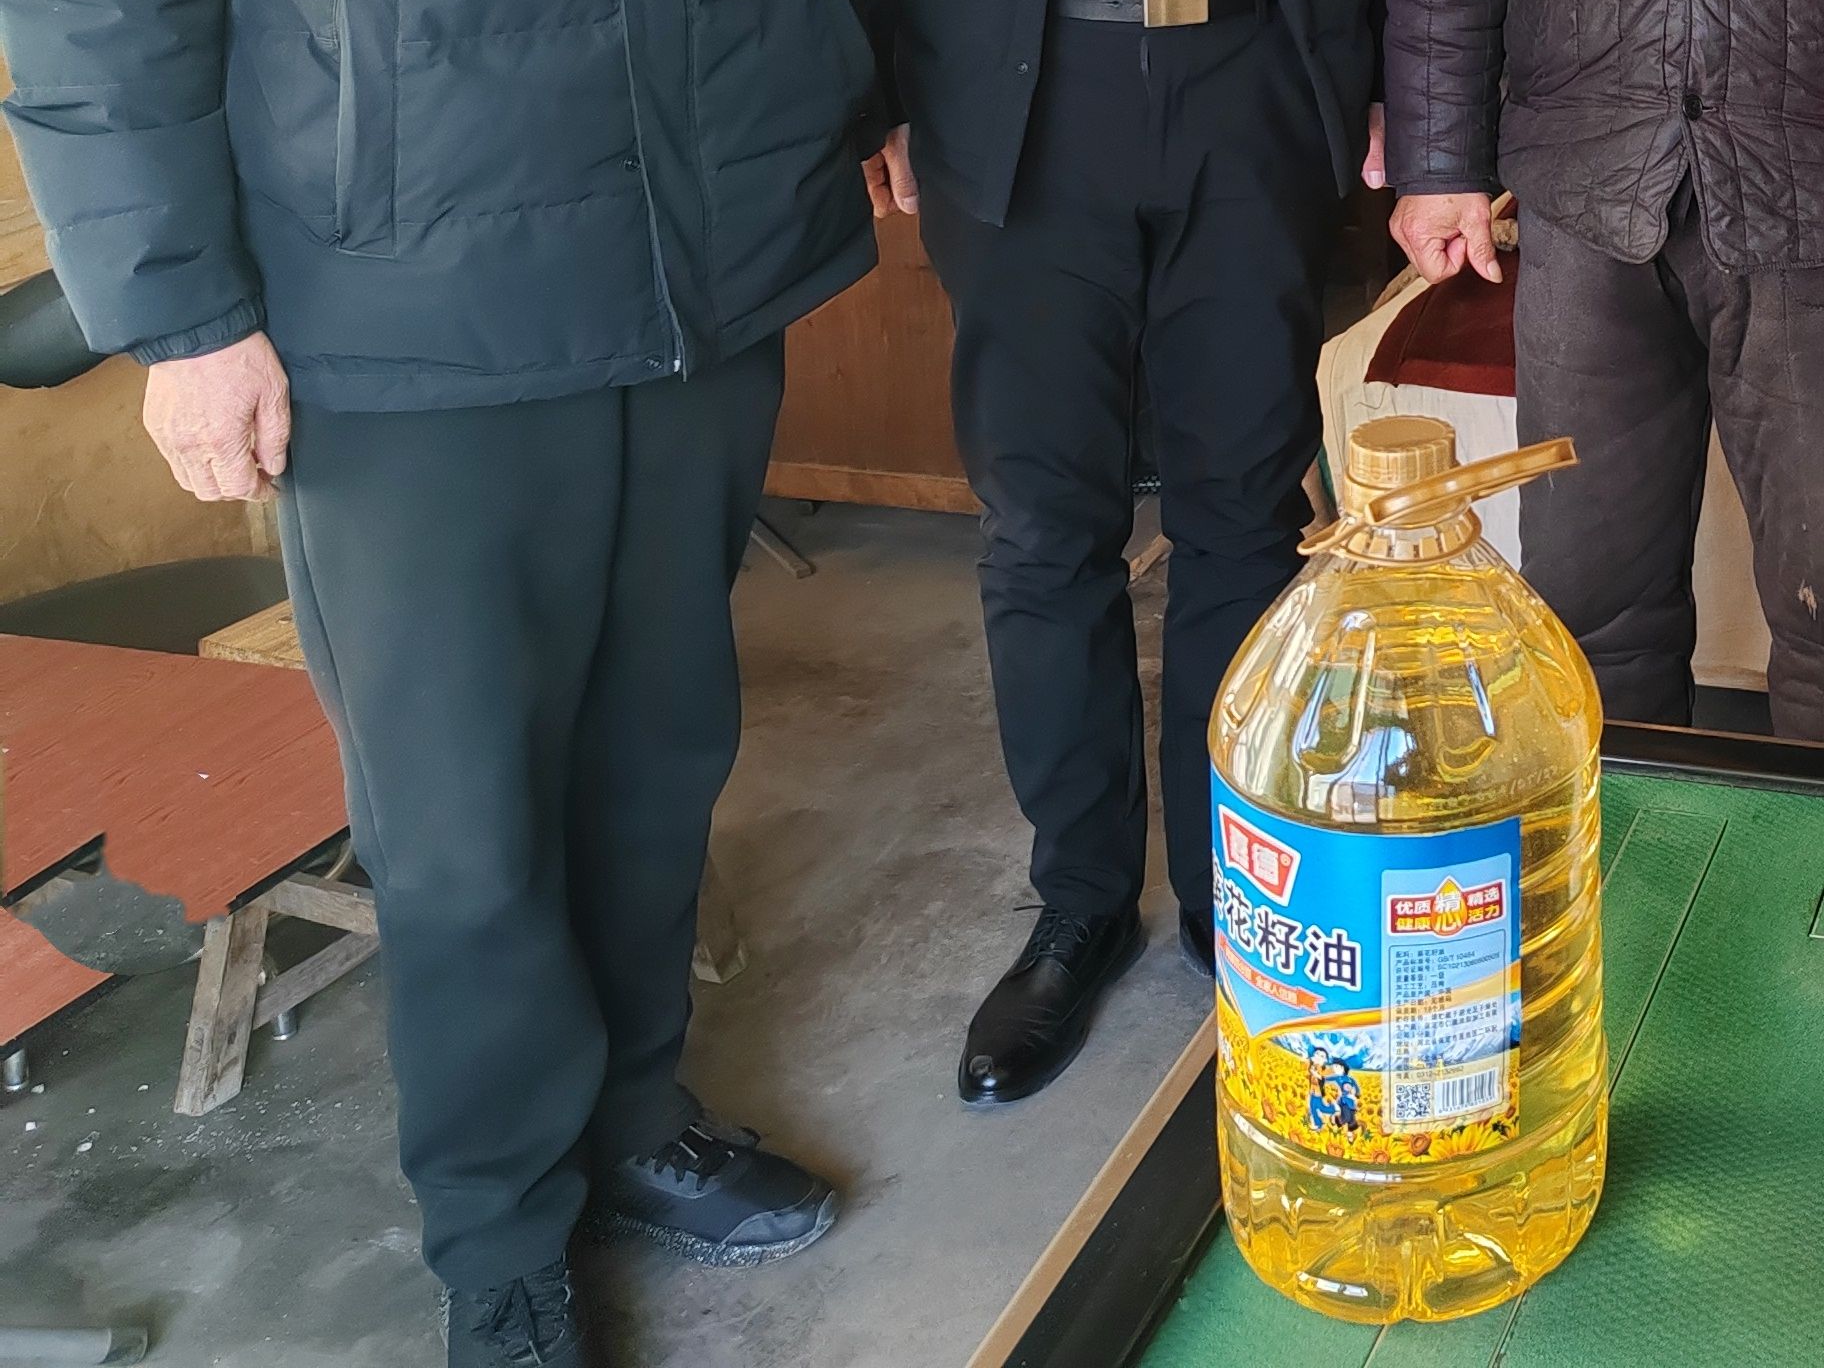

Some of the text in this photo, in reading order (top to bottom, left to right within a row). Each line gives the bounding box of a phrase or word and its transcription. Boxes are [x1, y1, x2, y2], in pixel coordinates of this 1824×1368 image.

[1395, 900, 1431, 914] 优质
[1396, 904, 1499, 930] 健康 活力
